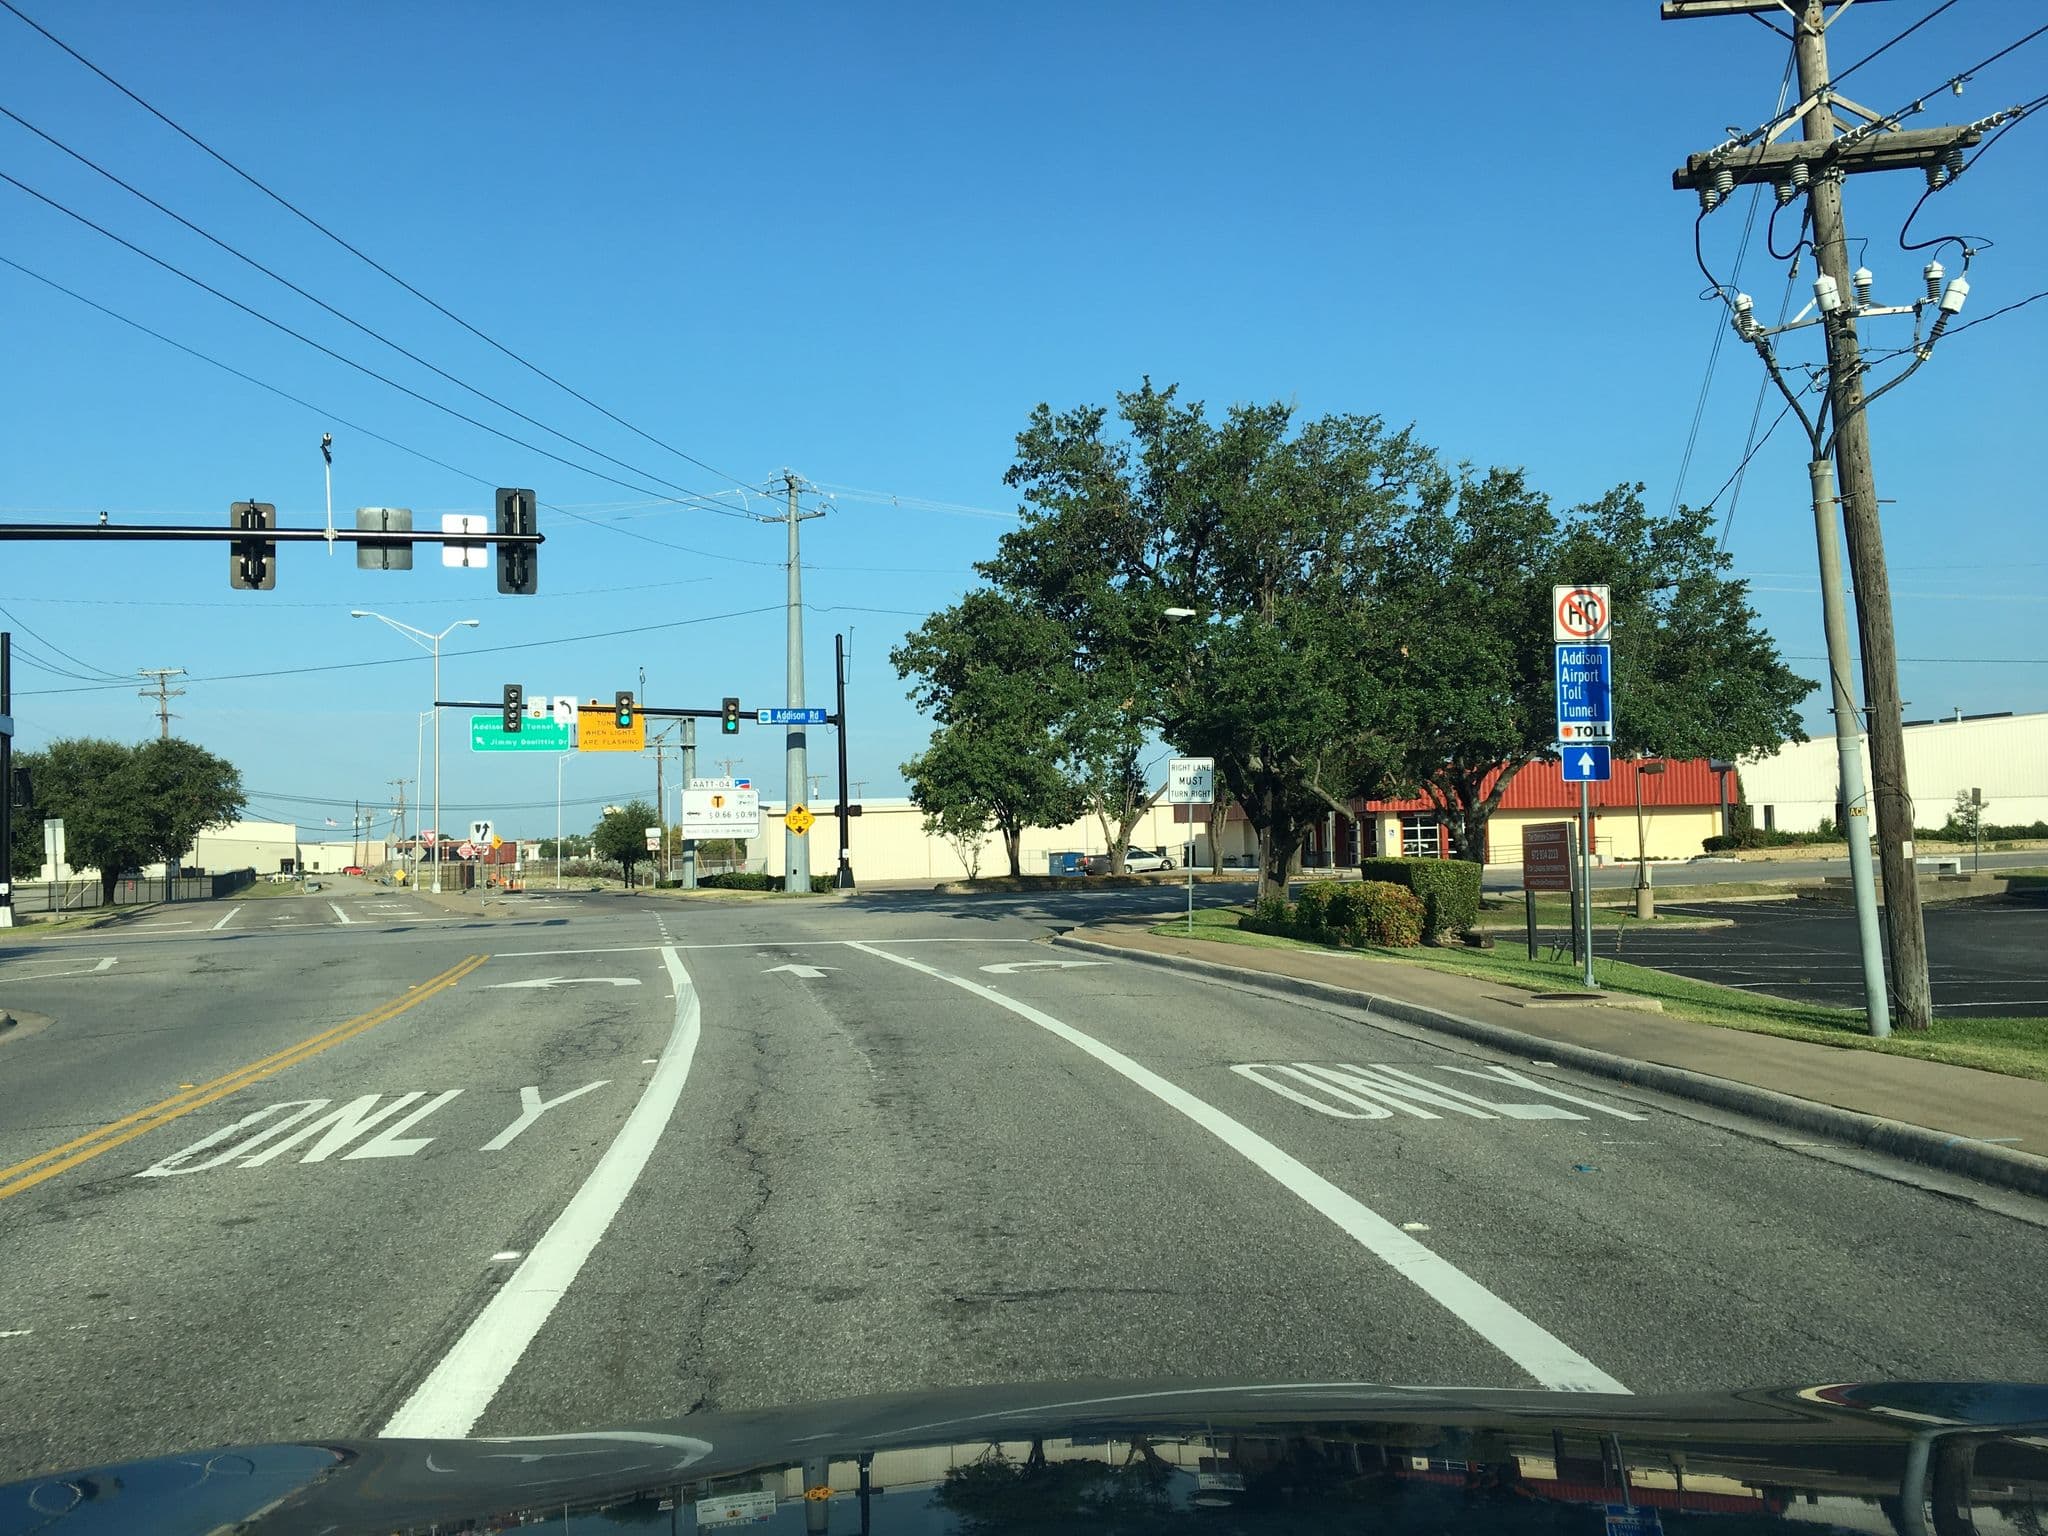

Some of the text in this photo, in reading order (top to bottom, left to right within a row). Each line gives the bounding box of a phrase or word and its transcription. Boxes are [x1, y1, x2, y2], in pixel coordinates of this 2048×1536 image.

[1568, 600, 1598, 626] HC
[1561, 649, 1603, 665] Addison
[1561, 667, 1599, 685] Airport
[1561, 684, 1582, 700] Toll
[776, 710, 819, 720] Addison Rd
[1562, 702, 1598, 718] Tunnel
[1575, 725, 1610, 737] TOLL
[490, 738, 517, 746] Jimmy
[1171, 764, 1211, 772] RIGHT LANE
[693, 780, 731, 788] AATT-04
[1179, 776, 1203, 785] MUST
[1191, 790, 1211, 798] RIGHT
[713, 795, 723, 809] T
[1229, 1062, 1649, 1121] ONLY
[131, 1079, 613, 1178] ONLY
